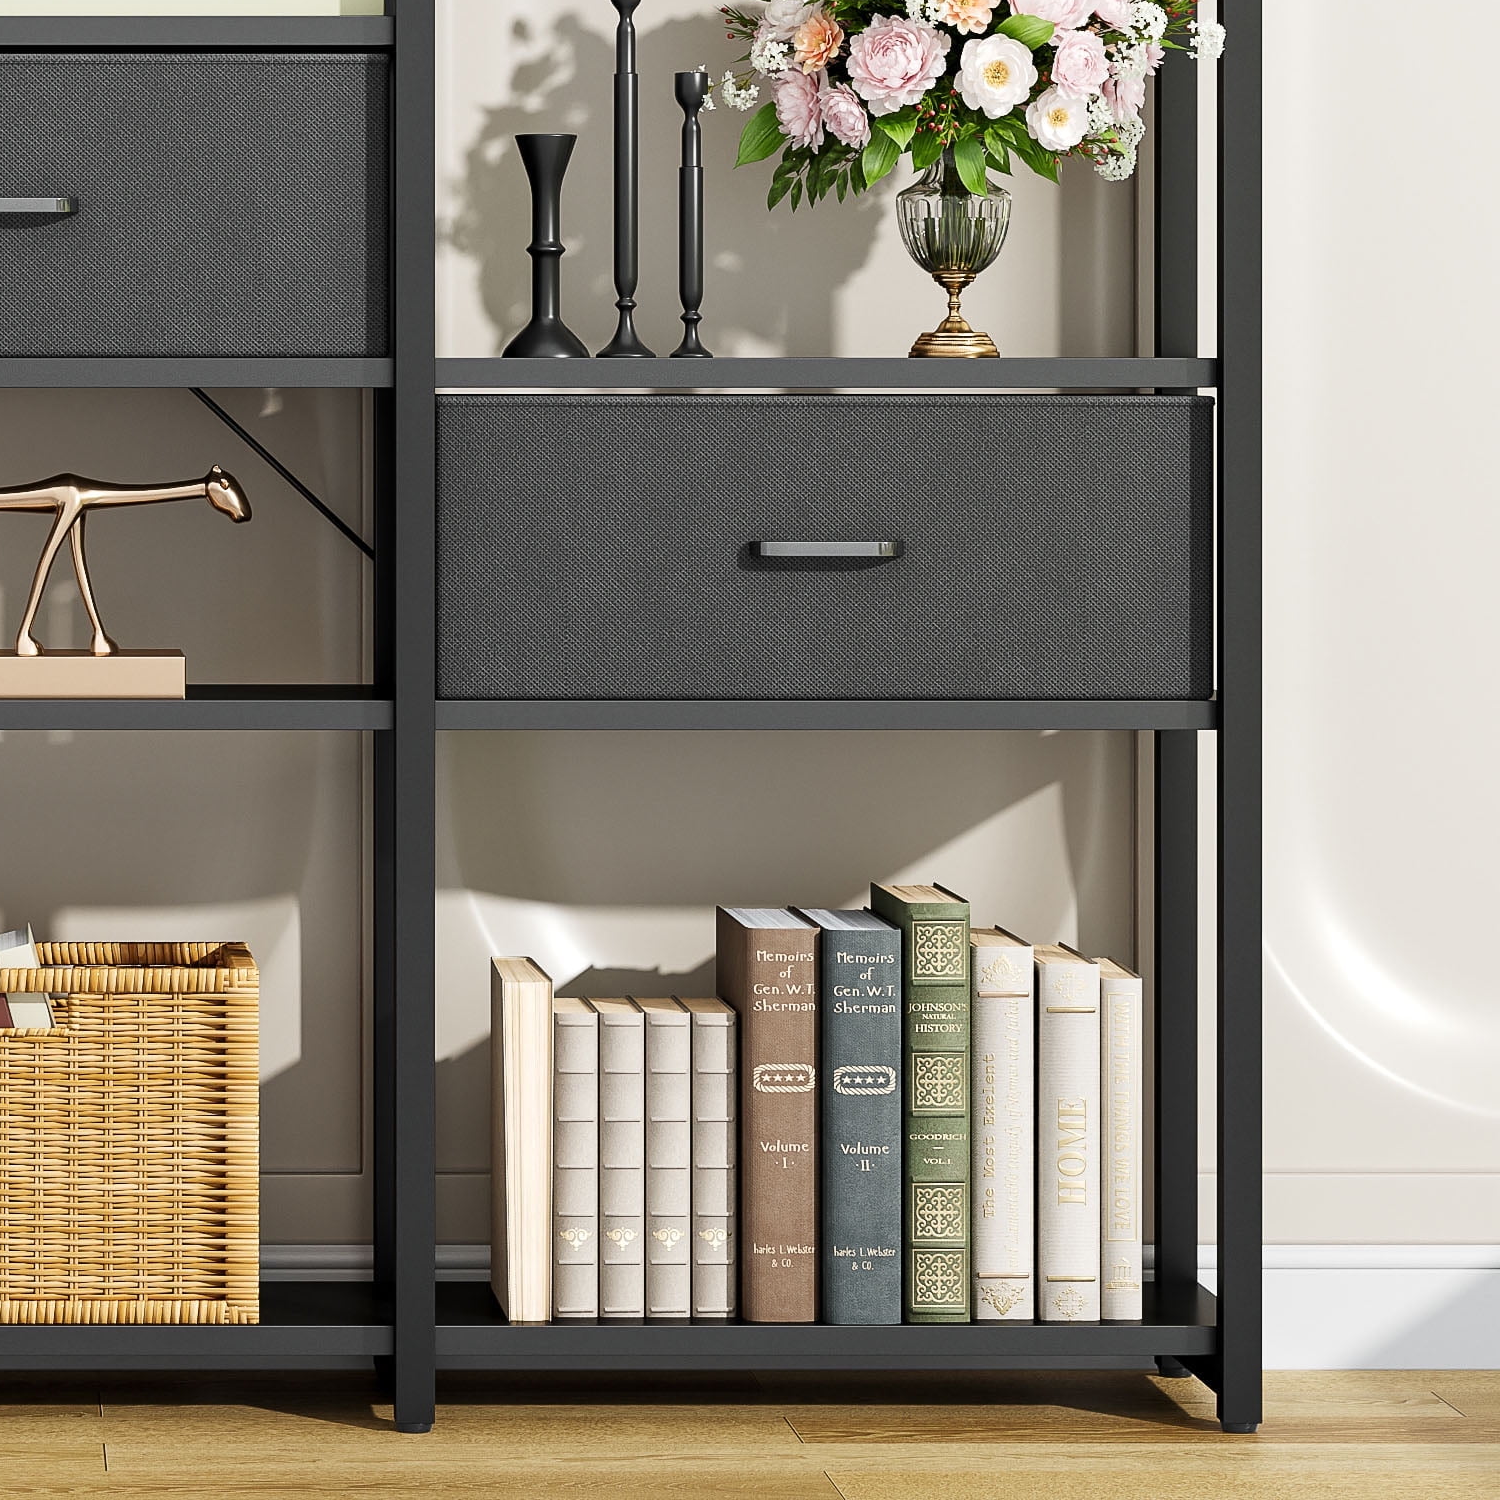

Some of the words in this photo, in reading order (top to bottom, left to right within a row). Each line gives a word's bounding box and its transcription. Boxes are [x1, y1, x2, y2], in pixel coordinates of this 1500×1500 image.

[756, 950, 814, 963] Memoirs
[836, 952, 894, 964] Memoirs
[779, 965, 794, 979] of
[859, 967, 875, 980] of
[753, 984, 784, 995] Gen.
[786, 984, 816, 995] W.T.
[833, 985, 864, 997] Gen.
[866, 985, 896, 997] W.T.
[753, 999, 816, 1012] Sherman
[833, 1001, 896, 1014] Sherman
[908, 1002, 968, 1014] JOHNSON'S
[915, 1023, 963, 1033] HISTORY
[1114, 1002, 1130, 1047] WITH
[1114, 1052, 1130, 1084] THE
[982, 1052, 995, 1126] Exelent
[760, 1140, 809, 1153] Volume
[840, 1142, 890, 1155] Volume
[1057, 1097, 1087, 1206] HOME
[982, 1135, 995, 1178] Most
[1114, 1157, 1130, 1183] WE
[982, 1187, 995, 1218] The
[1114, 1188, 1130, 1230] LOVE
[753, 1243, 776, 1254] harles
[833, 1245, 857, 1257] harles
[771, 1259, 778, 1268] &
[851, 1261, 858, 1271] &
